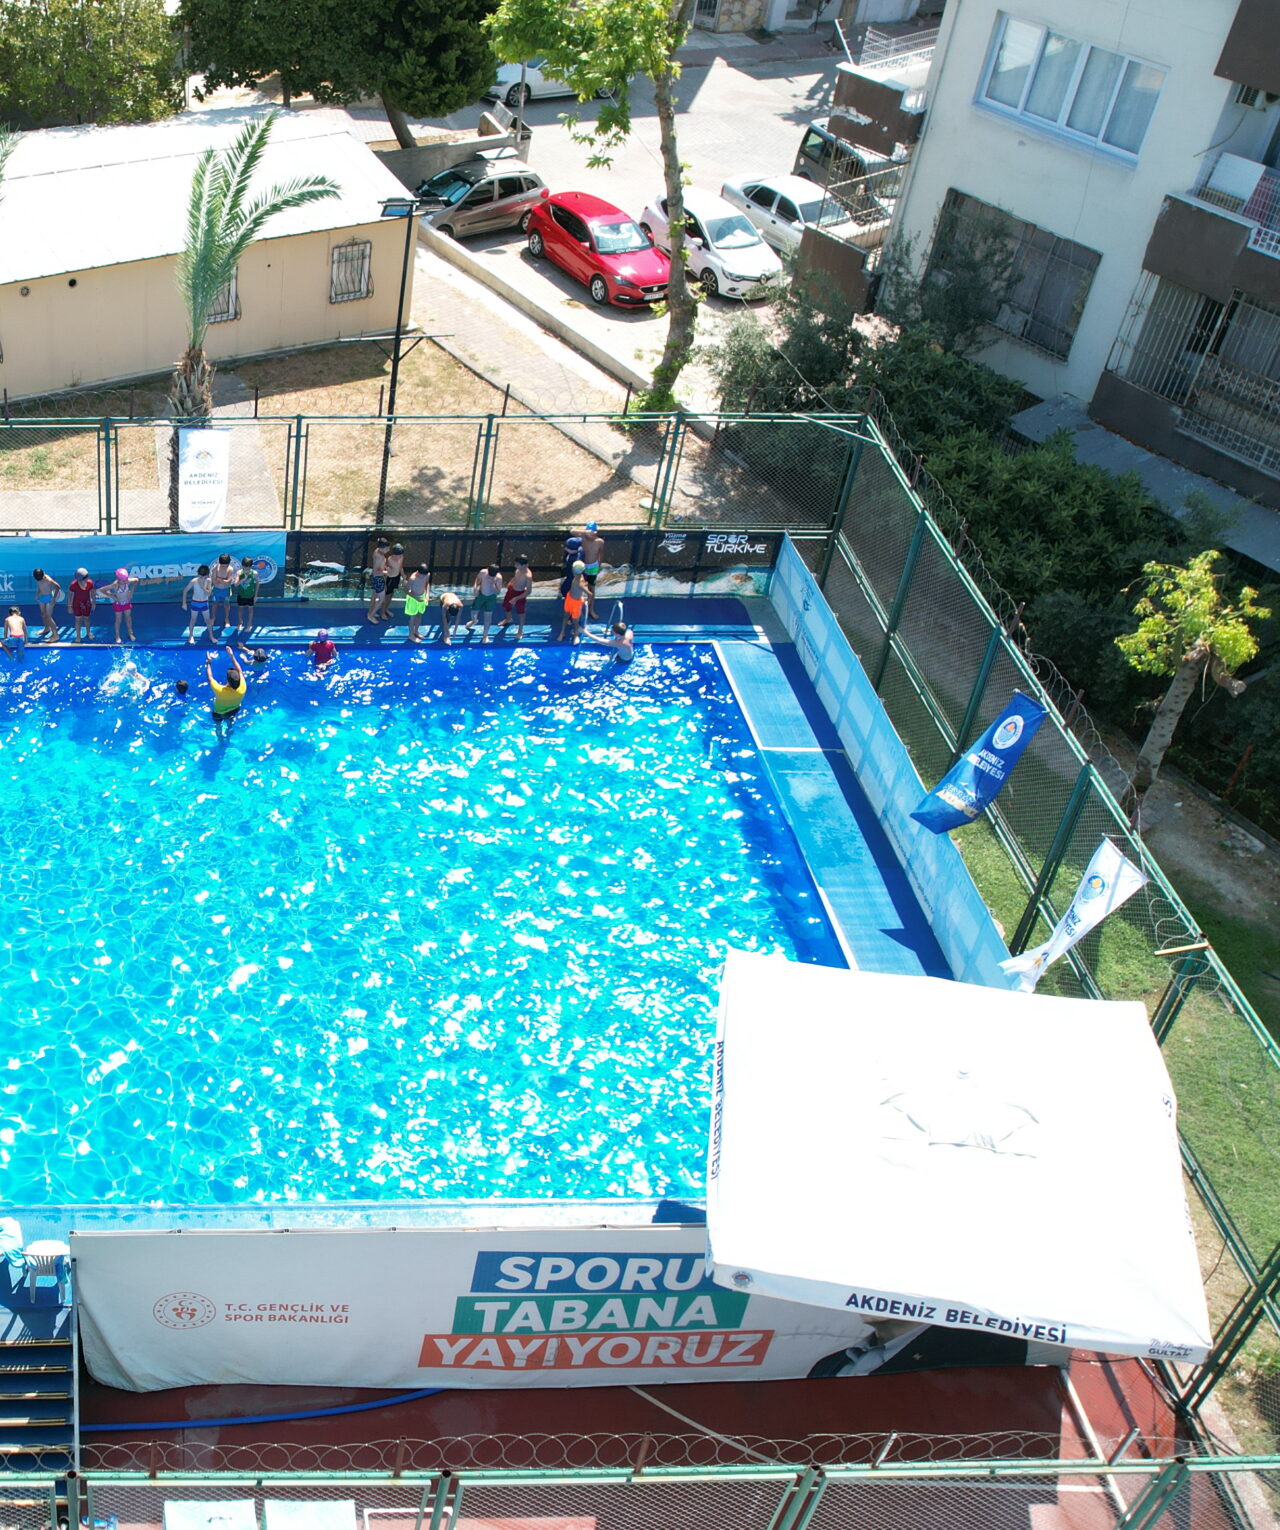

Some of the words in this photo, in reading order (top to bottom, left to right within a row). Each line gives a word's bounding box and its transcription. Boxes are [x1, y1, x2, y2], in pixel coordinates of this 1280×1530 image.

[705, 542, 767, 554] TÜRKİYE
[706, 534, 749, 544] SPOR
[495, 1256, 708, 1291] SPORU
[224, 1313, 264, 1323] SPOR
[268, 1313, 350, 1324] BAKANLIĞI
[225, 1303, 252, 1312] T.C.
[257, 1302, 325, 1314] GENÇLİK
[330, 1304, 350, 1313] VE
[474, 1295, 718, 1333] TABANA
[845, 1292, 937, 1320] AKDENİZ
[945, 1308, 1067, 1344] BELEDİYESİ
[433, 1333, 764, 1367] YAYIYORUZ
